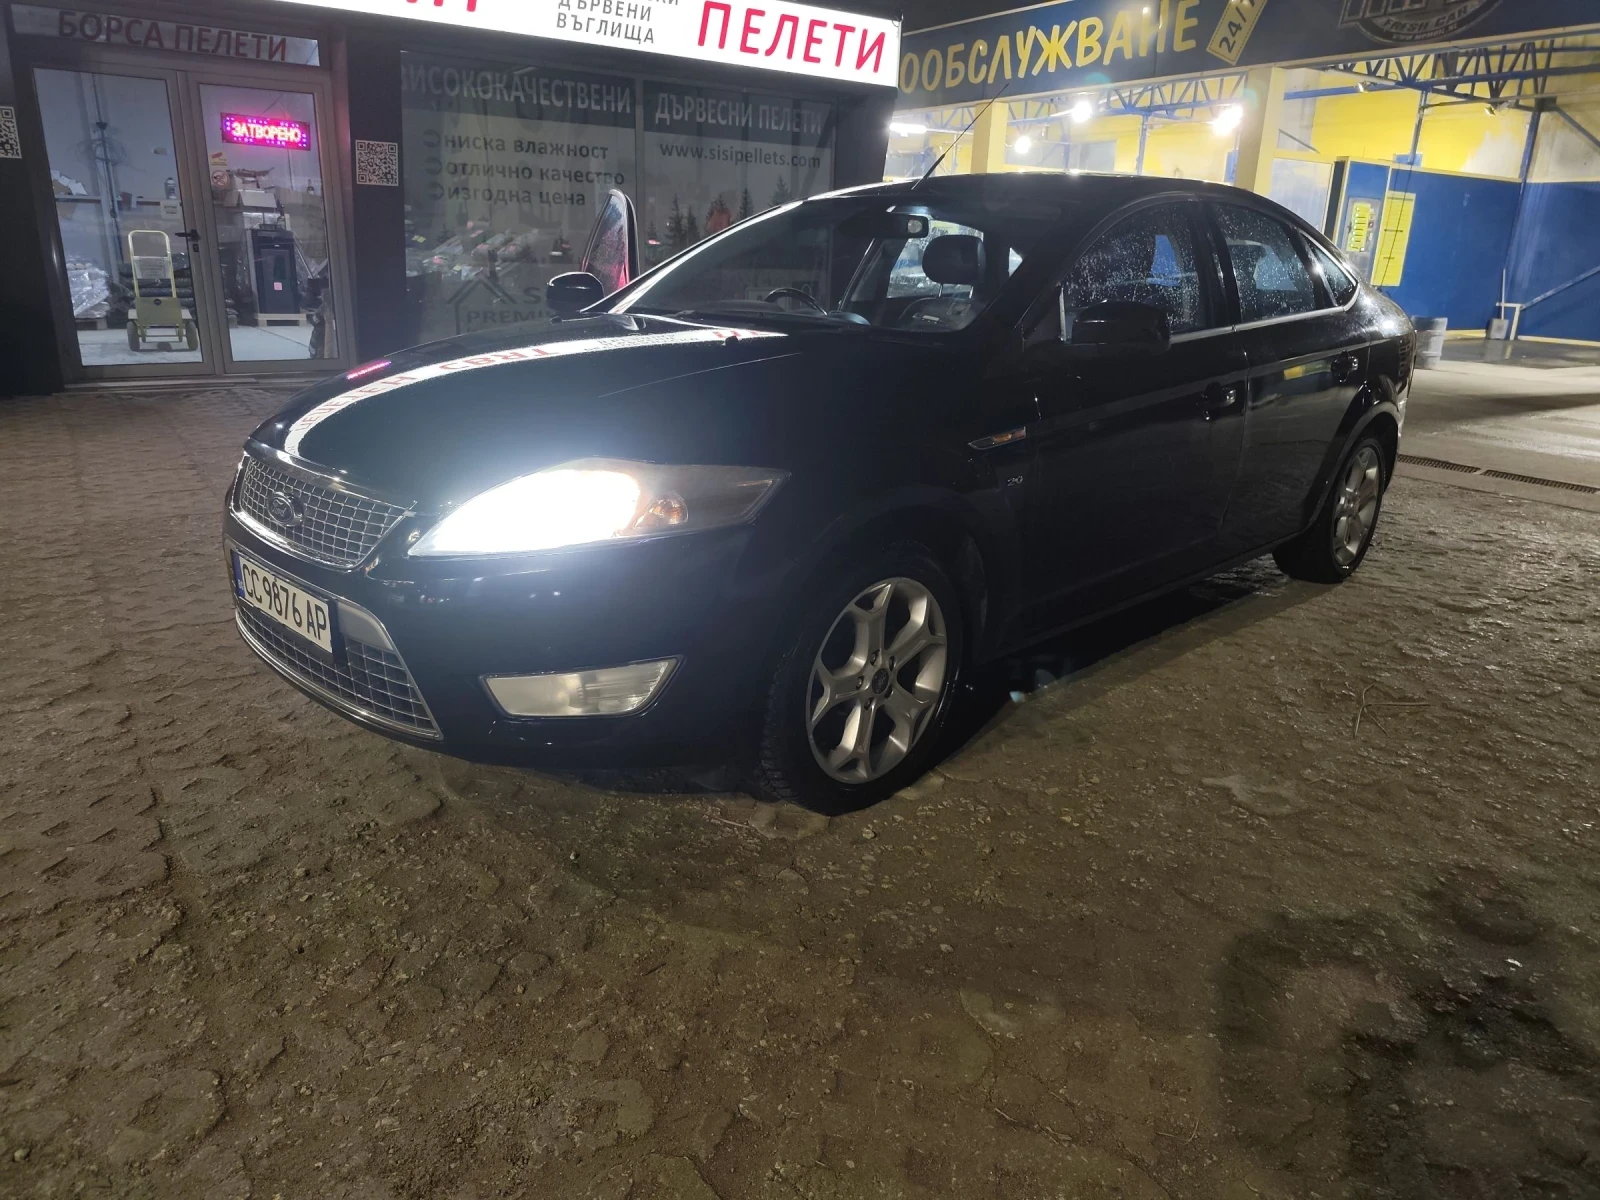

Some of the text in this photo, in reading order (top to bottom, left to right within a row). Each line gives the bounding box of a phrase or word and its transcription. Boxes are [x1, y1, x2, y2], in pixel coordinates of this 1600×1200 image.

[57, 10, 287, 62] БОРСА ПЕЛЕТИ
[556, 12, 654, 44] ВЪГЛИЩА
[697, 1, 886, 73] ПЕЛЕТИ
[655, 93, 822, 135] ДЪРВЕСНИ ПЕЛЕТИ
[232, 122, 301, 142] ЗАТВОРЕНО
[444, 134, 609, 160] ниска влажност
[659, 143, 821, 169] www.sisipellets.com
[445, 161, 625, 185] отлично качество
[447, 186, 586, 206] изгодна цена
